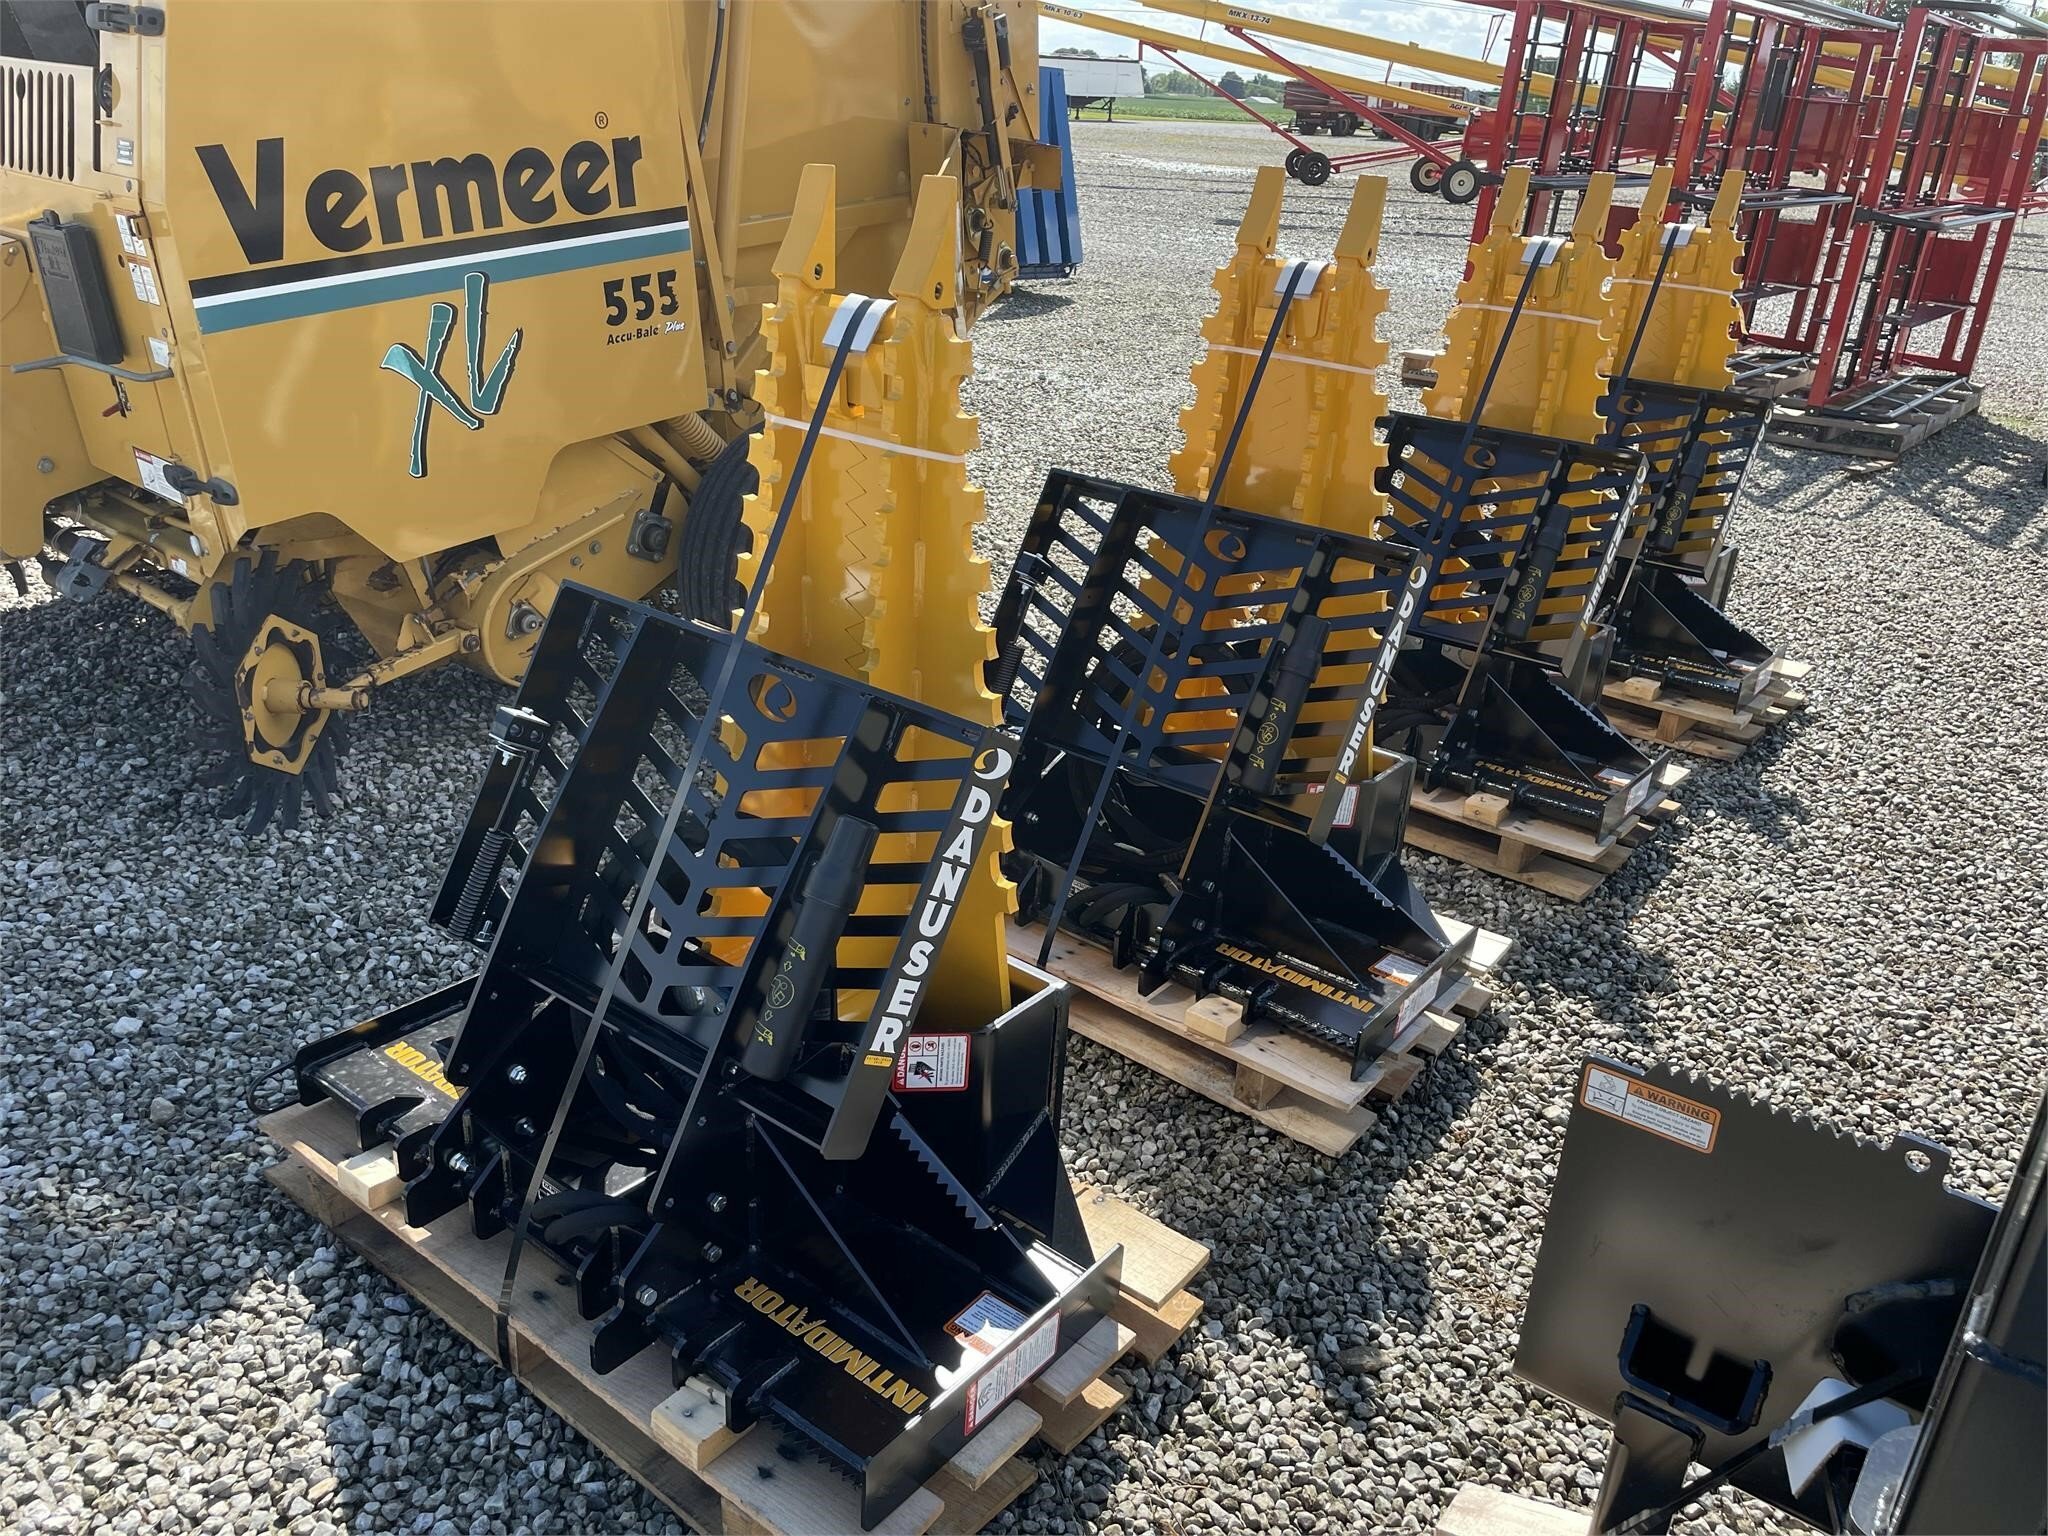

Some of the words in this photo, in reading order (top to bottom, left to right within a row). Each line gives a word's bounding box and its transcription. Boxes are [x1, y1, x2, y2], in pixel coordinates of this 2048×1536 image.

[1228, 9, 1248, 19] MKX
[1250, 14, 1271, 24] 13-74
[194, 134, 643, 265] Vermeer
[603, 269, 679, 326] 555
[607, 325, 659, 345] Accu-Bale
[664, 320, 685, 335] Plus
[1583, 484, 1638, 625] DANUSER
[1338, 591, 1414, 776] DANUSER
[869, 785, 992, 1054] DANUSER
[1215, 943, 1376, 1014] INTIMIDATOR
[1647, 1090, 1711, 1121] WARNING
[734, 1276, 929, 1414] INTIMIDATOR
